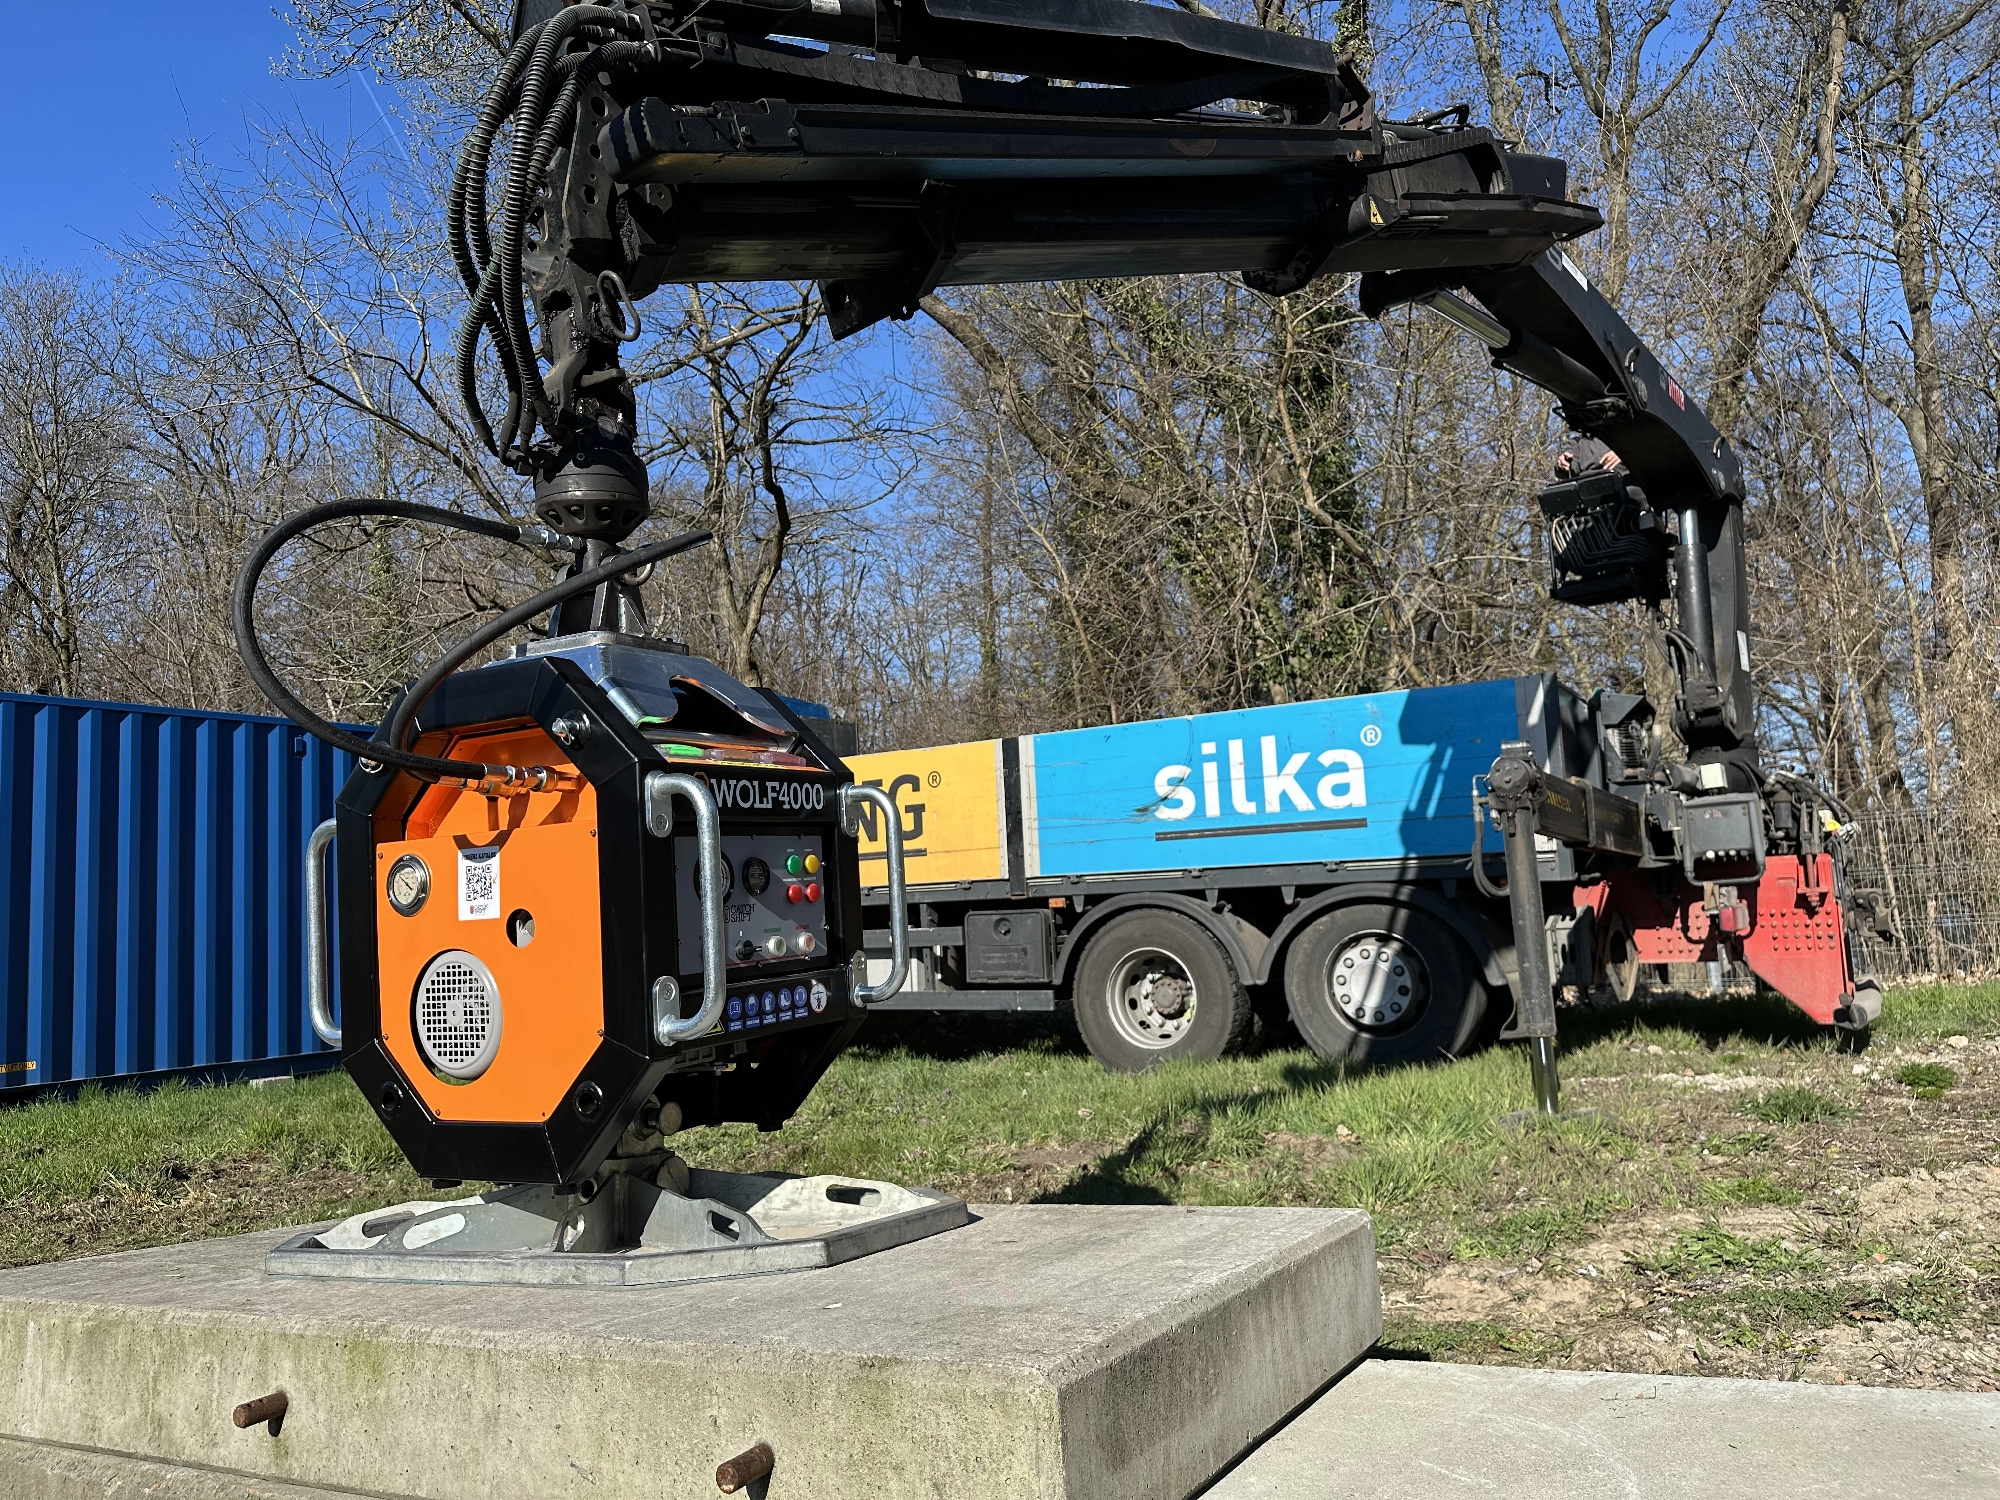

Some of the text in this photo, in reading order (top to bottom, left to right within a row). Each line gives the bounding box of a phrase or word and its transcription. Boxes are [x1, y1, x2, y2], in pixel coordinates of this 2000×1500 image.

[710, 778, 824, 810] WOLF4000
[730, 903, 755, 914] CATCH
[730, 912, 751, 923] SHIFT
